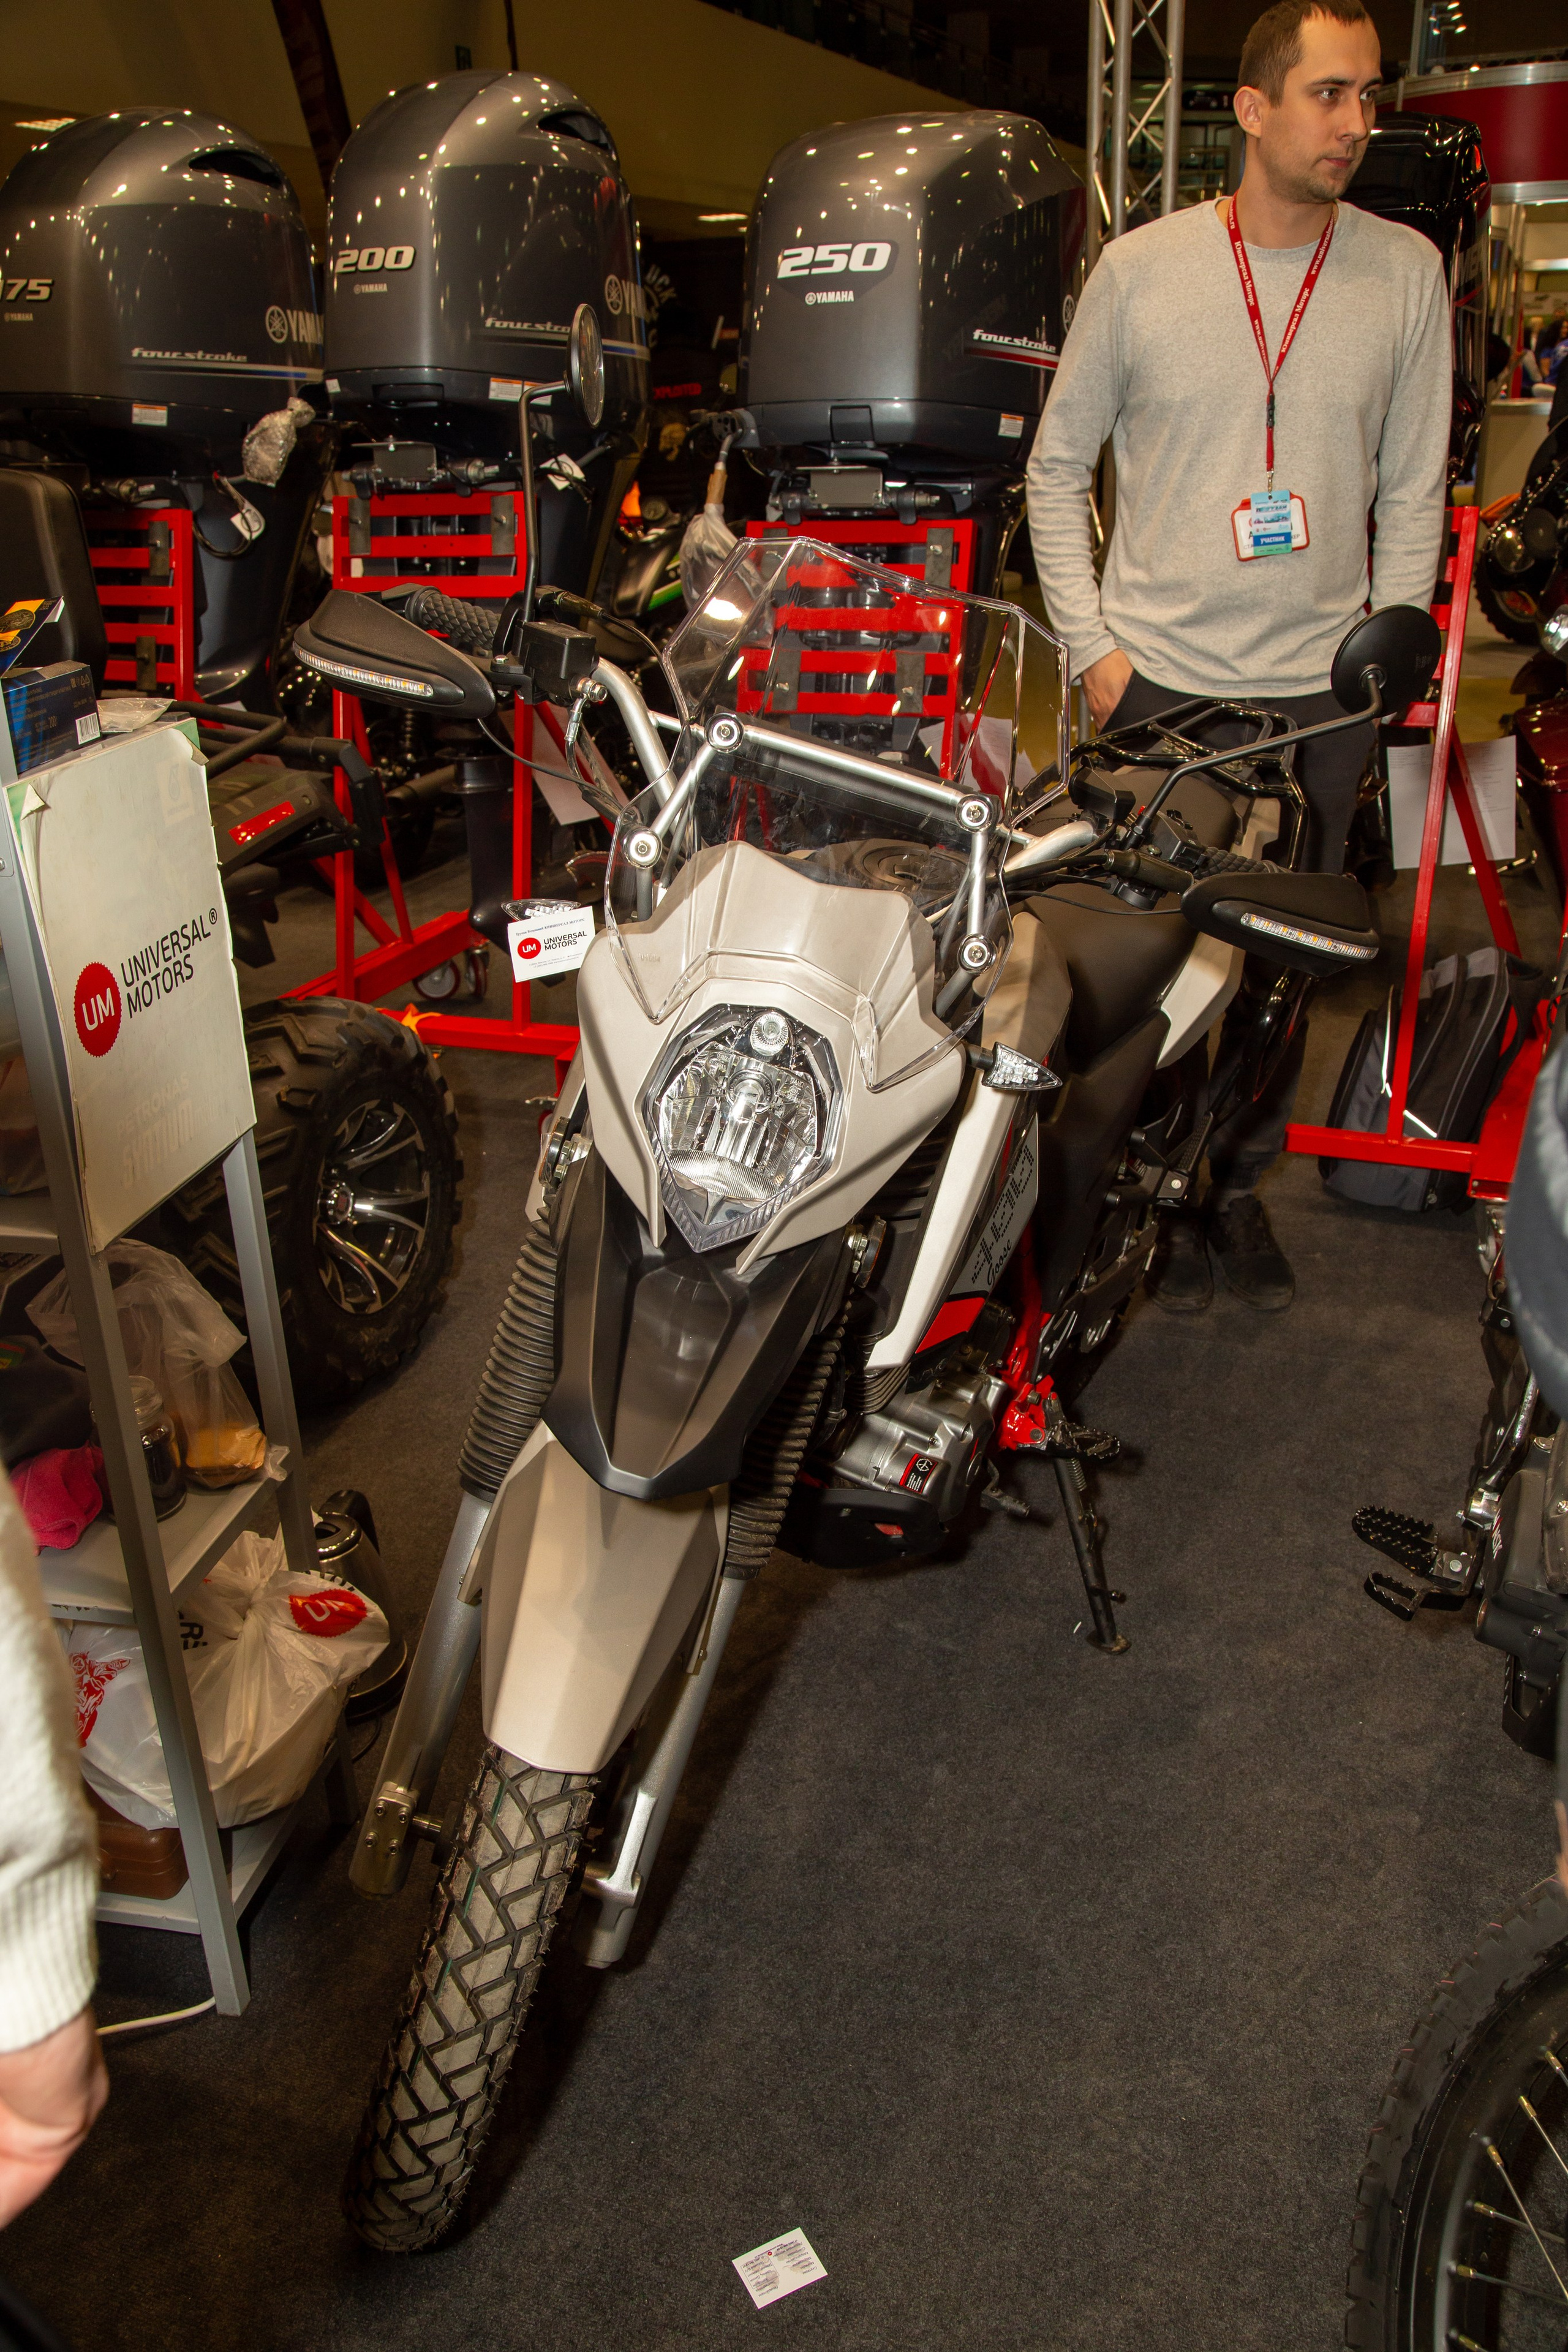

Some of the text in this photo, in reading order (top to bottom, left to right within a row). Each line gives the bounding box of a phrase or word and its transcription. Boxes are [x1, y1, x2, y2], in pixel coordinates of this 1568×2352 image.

[335, 246, 415, 274] 200
[777, 243, 891, 279] 250
[1234, 241, 1255, 306] Юниверсал Моторс
[361, 283, 388, 293] YAMAHA
[816, 290, 854, 303] YAMAHA
[485, 317, 571, 333] fourstro
[1281, 287, 1310, 353] Юниверсал Моторс
[652, 383, 702, 400] XPLOITED
[1260, 536, 1285, 545] УЧАСТНИК
[522, 943, 537, 953] UM
[543, 931, 587, 944] UNIVERSAL
[545, 939, 577, 951] MOTORS
[127, 954, 194, 1019] MOTORS
[82, 988, 115, 1030] UM
[971, 1144, 1035, 1284] 400
[987, 1239, 1012, 1286] Goose
